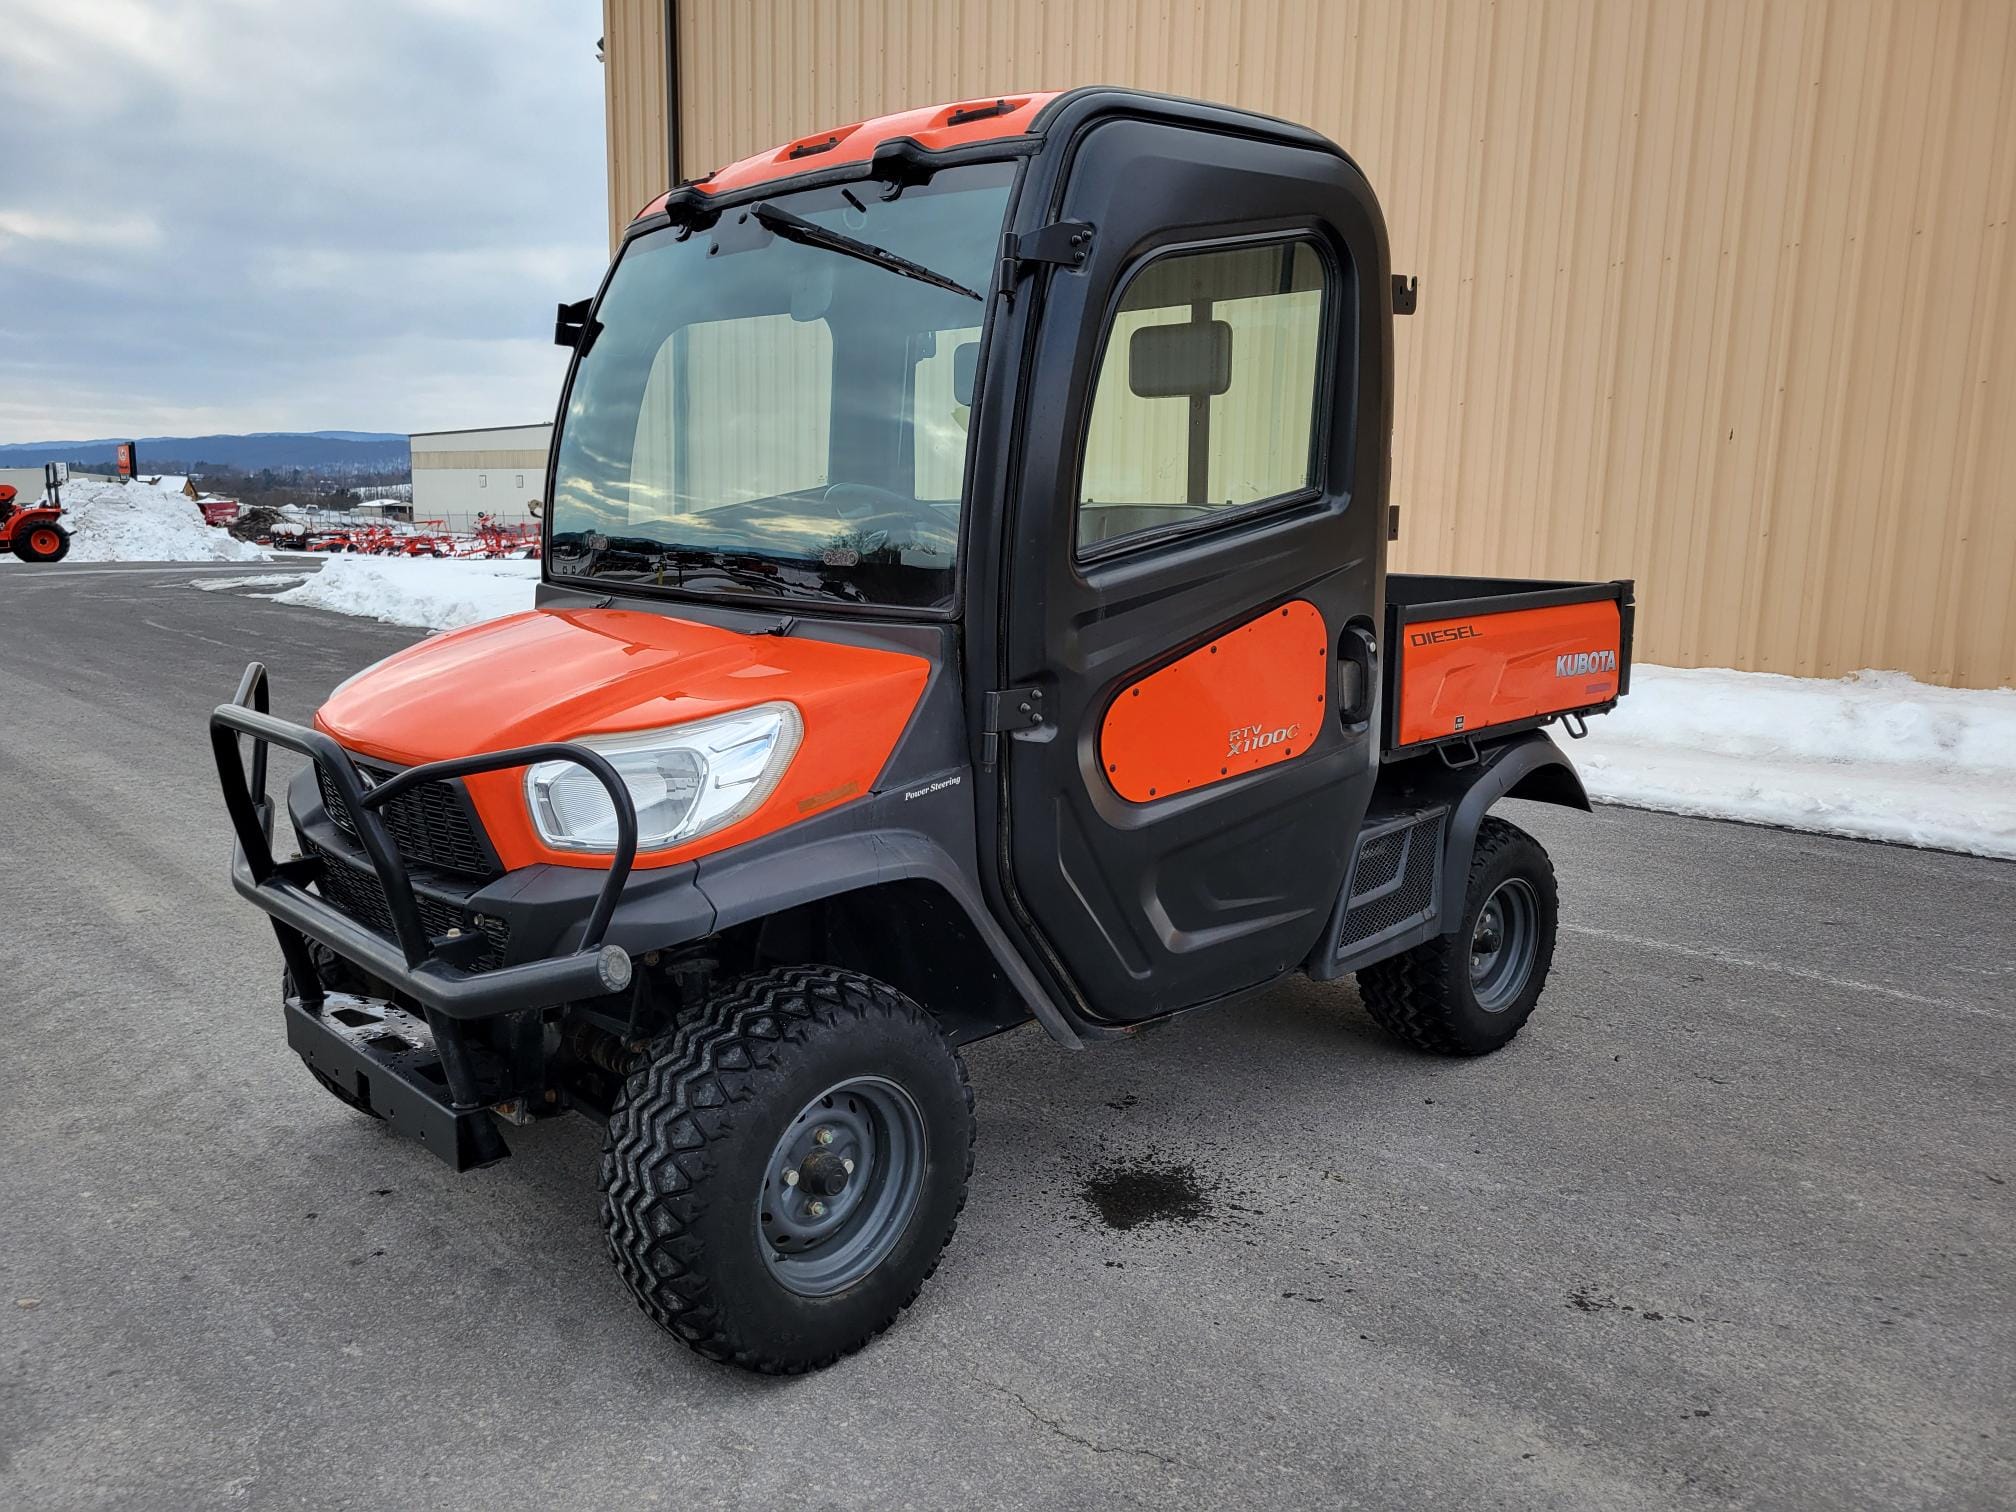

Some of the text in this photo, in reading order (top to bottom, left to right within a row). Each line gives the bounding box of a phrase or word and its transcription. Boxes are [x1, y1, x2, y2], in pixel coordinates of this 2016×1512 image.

[1410, 625, 1483, 647] DIESEL
[1556, 650, 1617, 678] KUBOTA
[1226, 723, 1300, 758] X1100C
[1229, 724, 1262, 742] RTV
[904, 776, 961, 801] Power Steering
